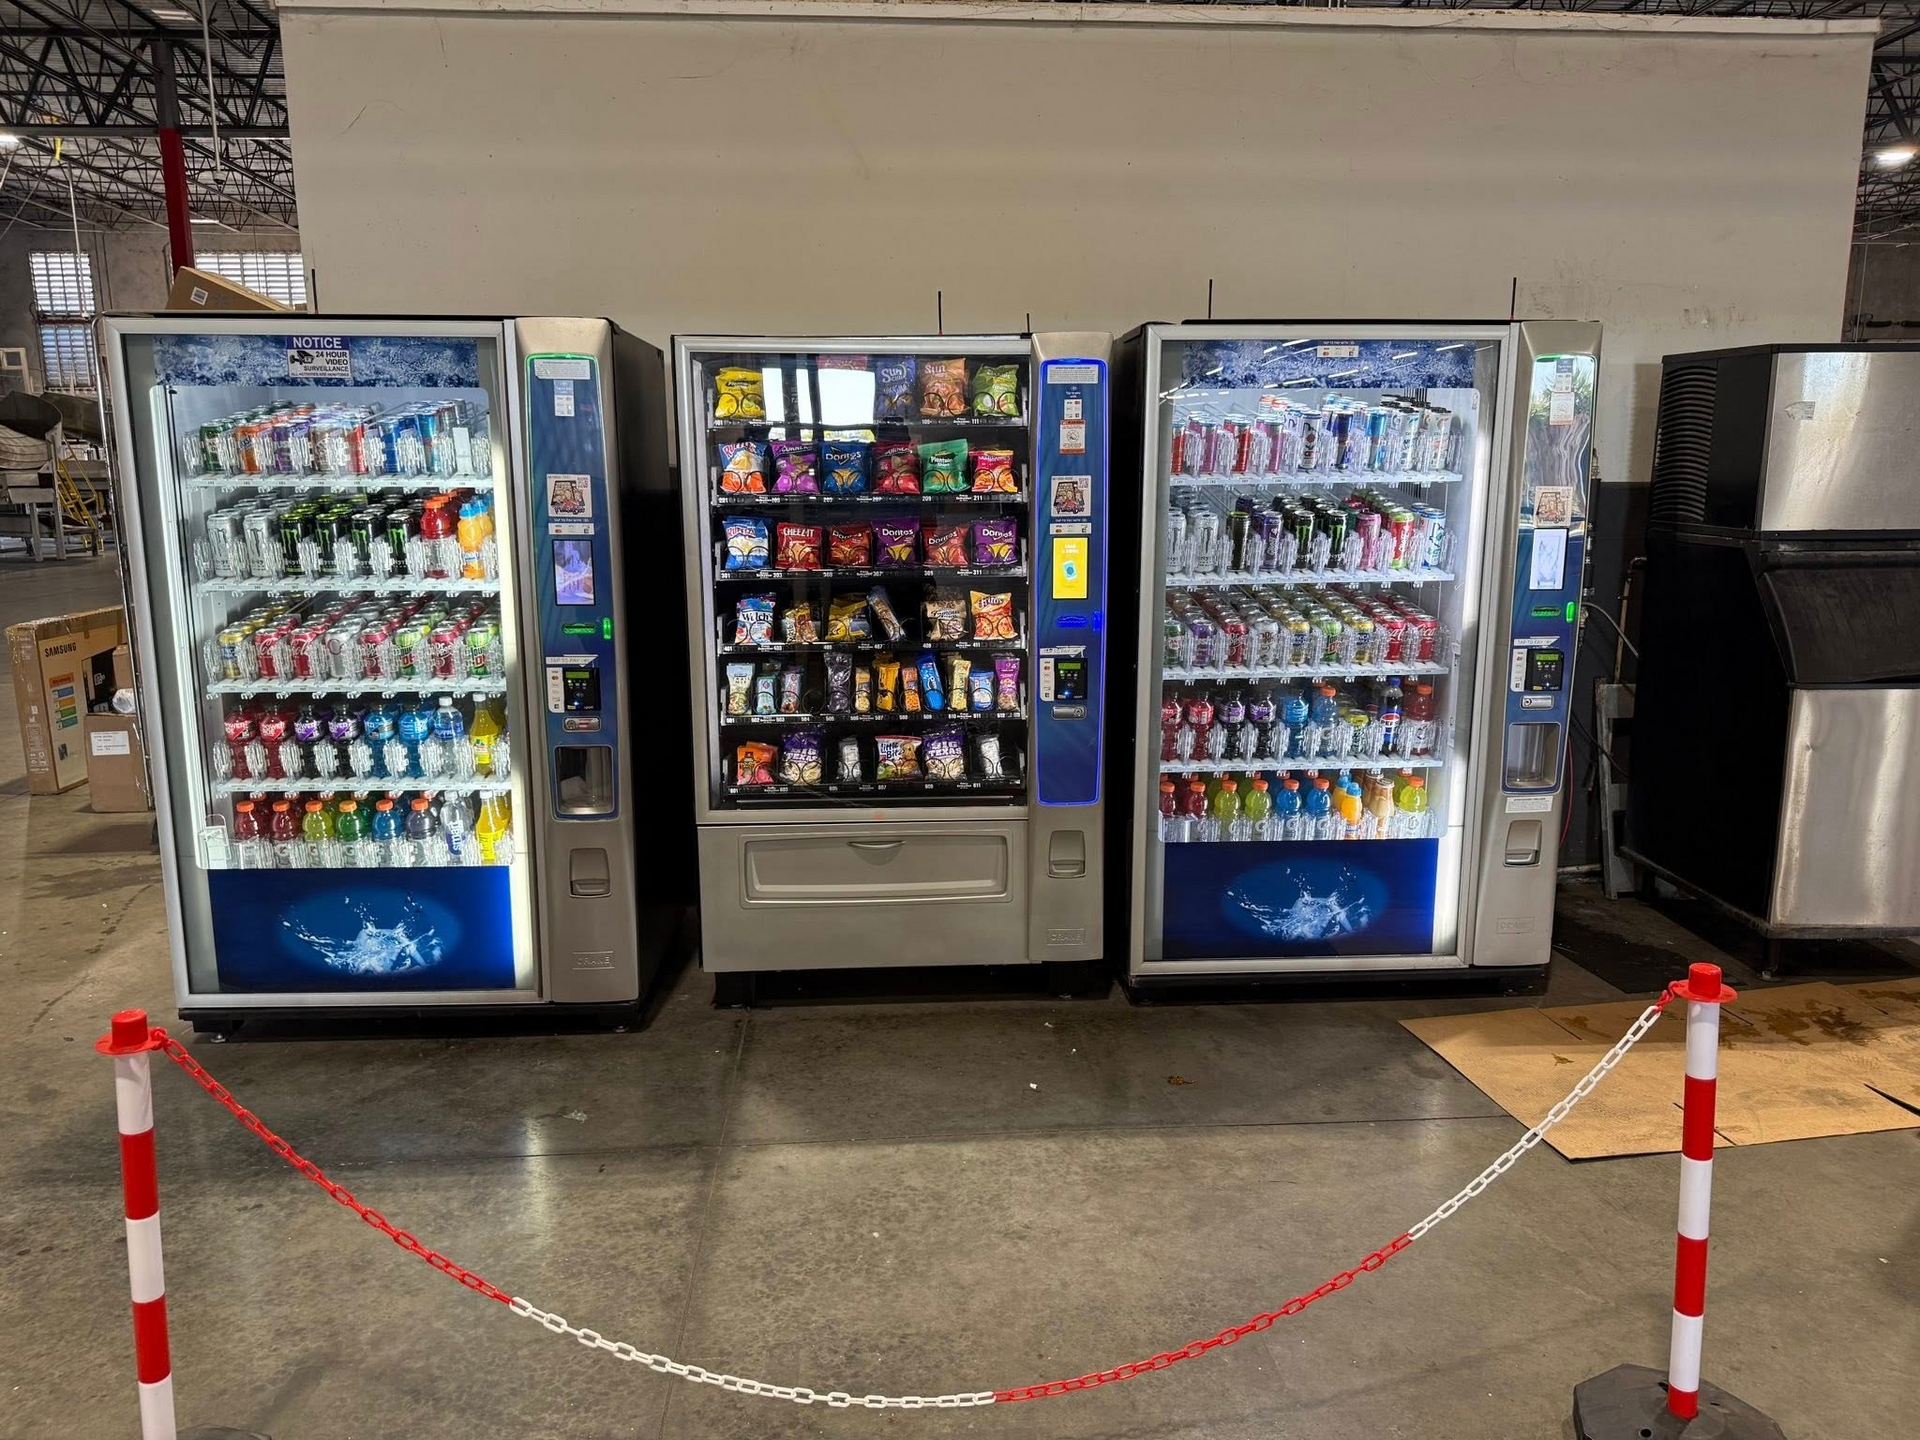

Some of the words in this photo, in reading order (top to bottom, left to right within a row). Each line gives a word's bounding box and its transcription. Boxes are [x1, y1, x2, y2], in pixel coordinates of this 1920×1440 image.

[293, 337, 341, 348] NOTICE
[825, 452, 862, 462] Doritos
[882, 528, 914, 536] Doritos
[982, 528, 1014, 538] Doritos
[928, 531, 958, 545] Doritos
[742, 612, 774, 622] Welch's
[44, 642, 77, 658] SAMSUNG
[786, 753, 818, 761] TEXAS
[928, 748, 962, 757] TEXAS
